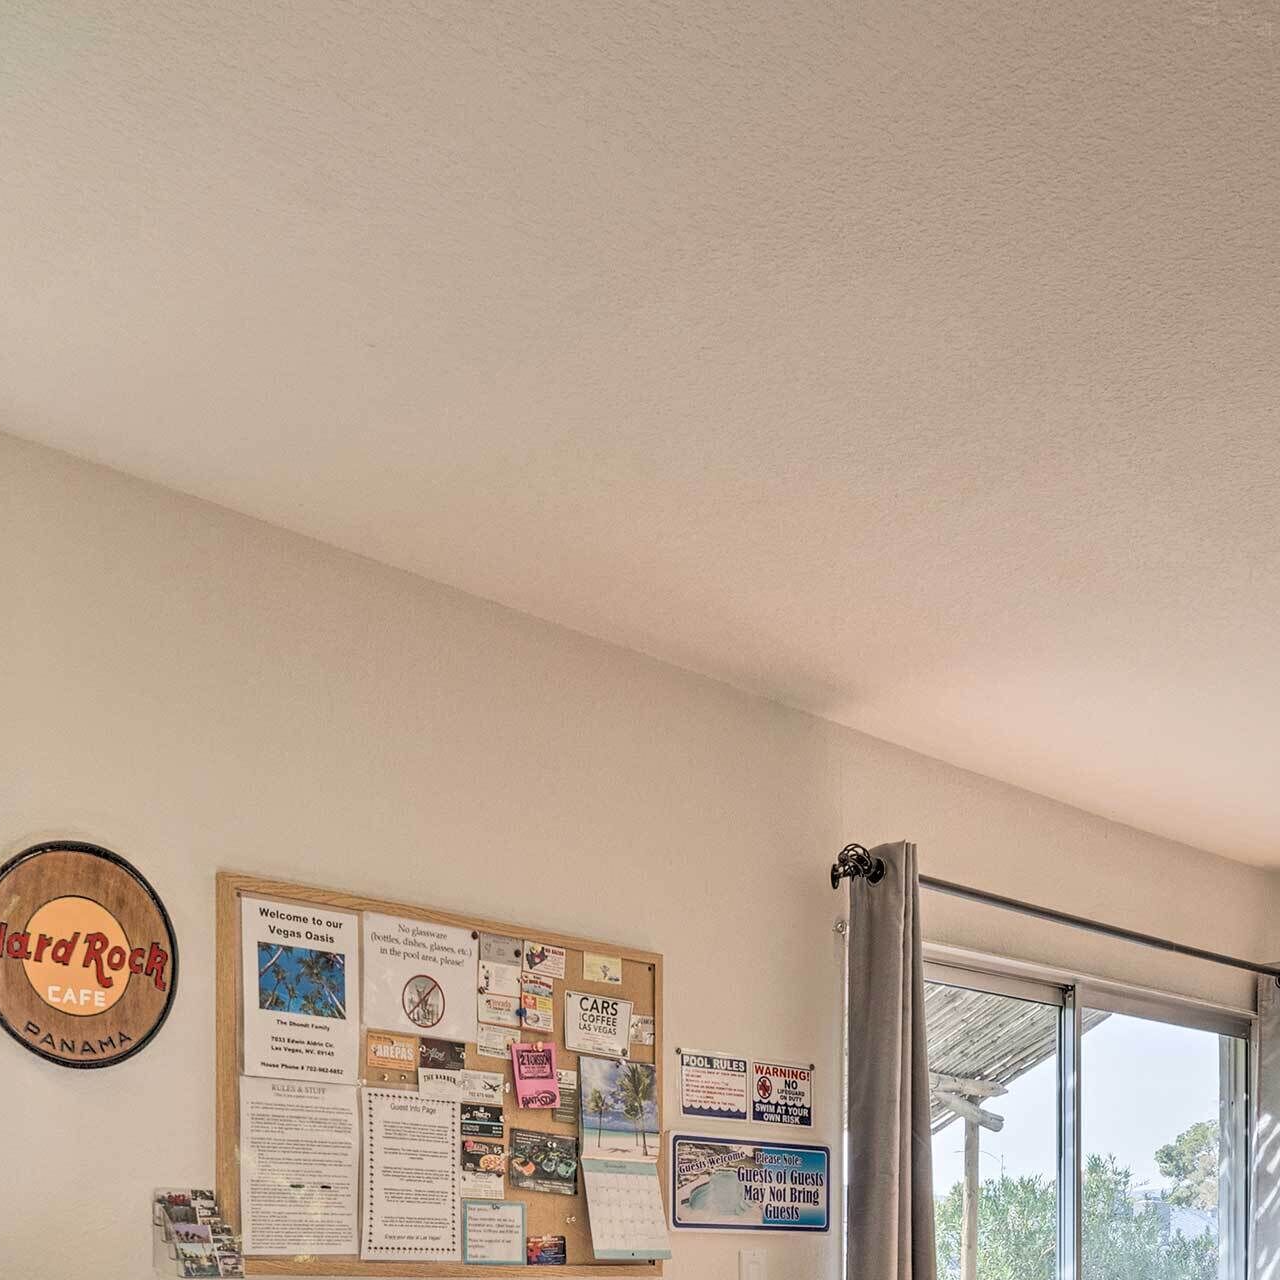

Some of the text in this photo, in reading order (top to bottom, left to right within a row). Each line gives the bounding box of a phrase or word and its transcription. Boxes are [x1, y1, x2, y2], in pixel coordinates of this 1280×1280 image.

[259, 907, 343, 929] Welcome to our
[268, 924, 335, 943] Vegas Oasis
[398, 924, 448, 939] No glassware
[82, 931, 169, 992] Rock
[380, 946, 388, 954] in
[389, 947, 401, 957] the
[403, 949, 420, 960] pool
[48, 985, 107, 1007] CAFE
[580, 996, 619, 1017] CARS
[311, 1023, 330, 1031] Family
[581, 1012, 617, 1027] COFFEE
[579, 1022, 617, 1035] LAS VEGAS
[24, 1021, 132, 1056] PANAMA
[683, 1055, 710, 1068] POOL
[713, 1059, 745, 1072] RULES
[754, 1064, 811, 1083] WARNING!
[777, 1088, 805, 1098] LIFEGUARD
[784, 1079, 798, 1090] NO
[391, 1103, 408, 1111] Guest
[755, 1103, 809, 1117] SWIM AT YOUR
[763, 1113, 800, 1125] OWN RISK
[679, 1151, 746, 1174] Guests Welcome
[755, 1151, 781, 1165] Please
[737, 1166, 824, 1187] Guests of Guests
[744, 1184, 820, 1206] May Not Bring
[765, 1203, 800, 1221] Guests
